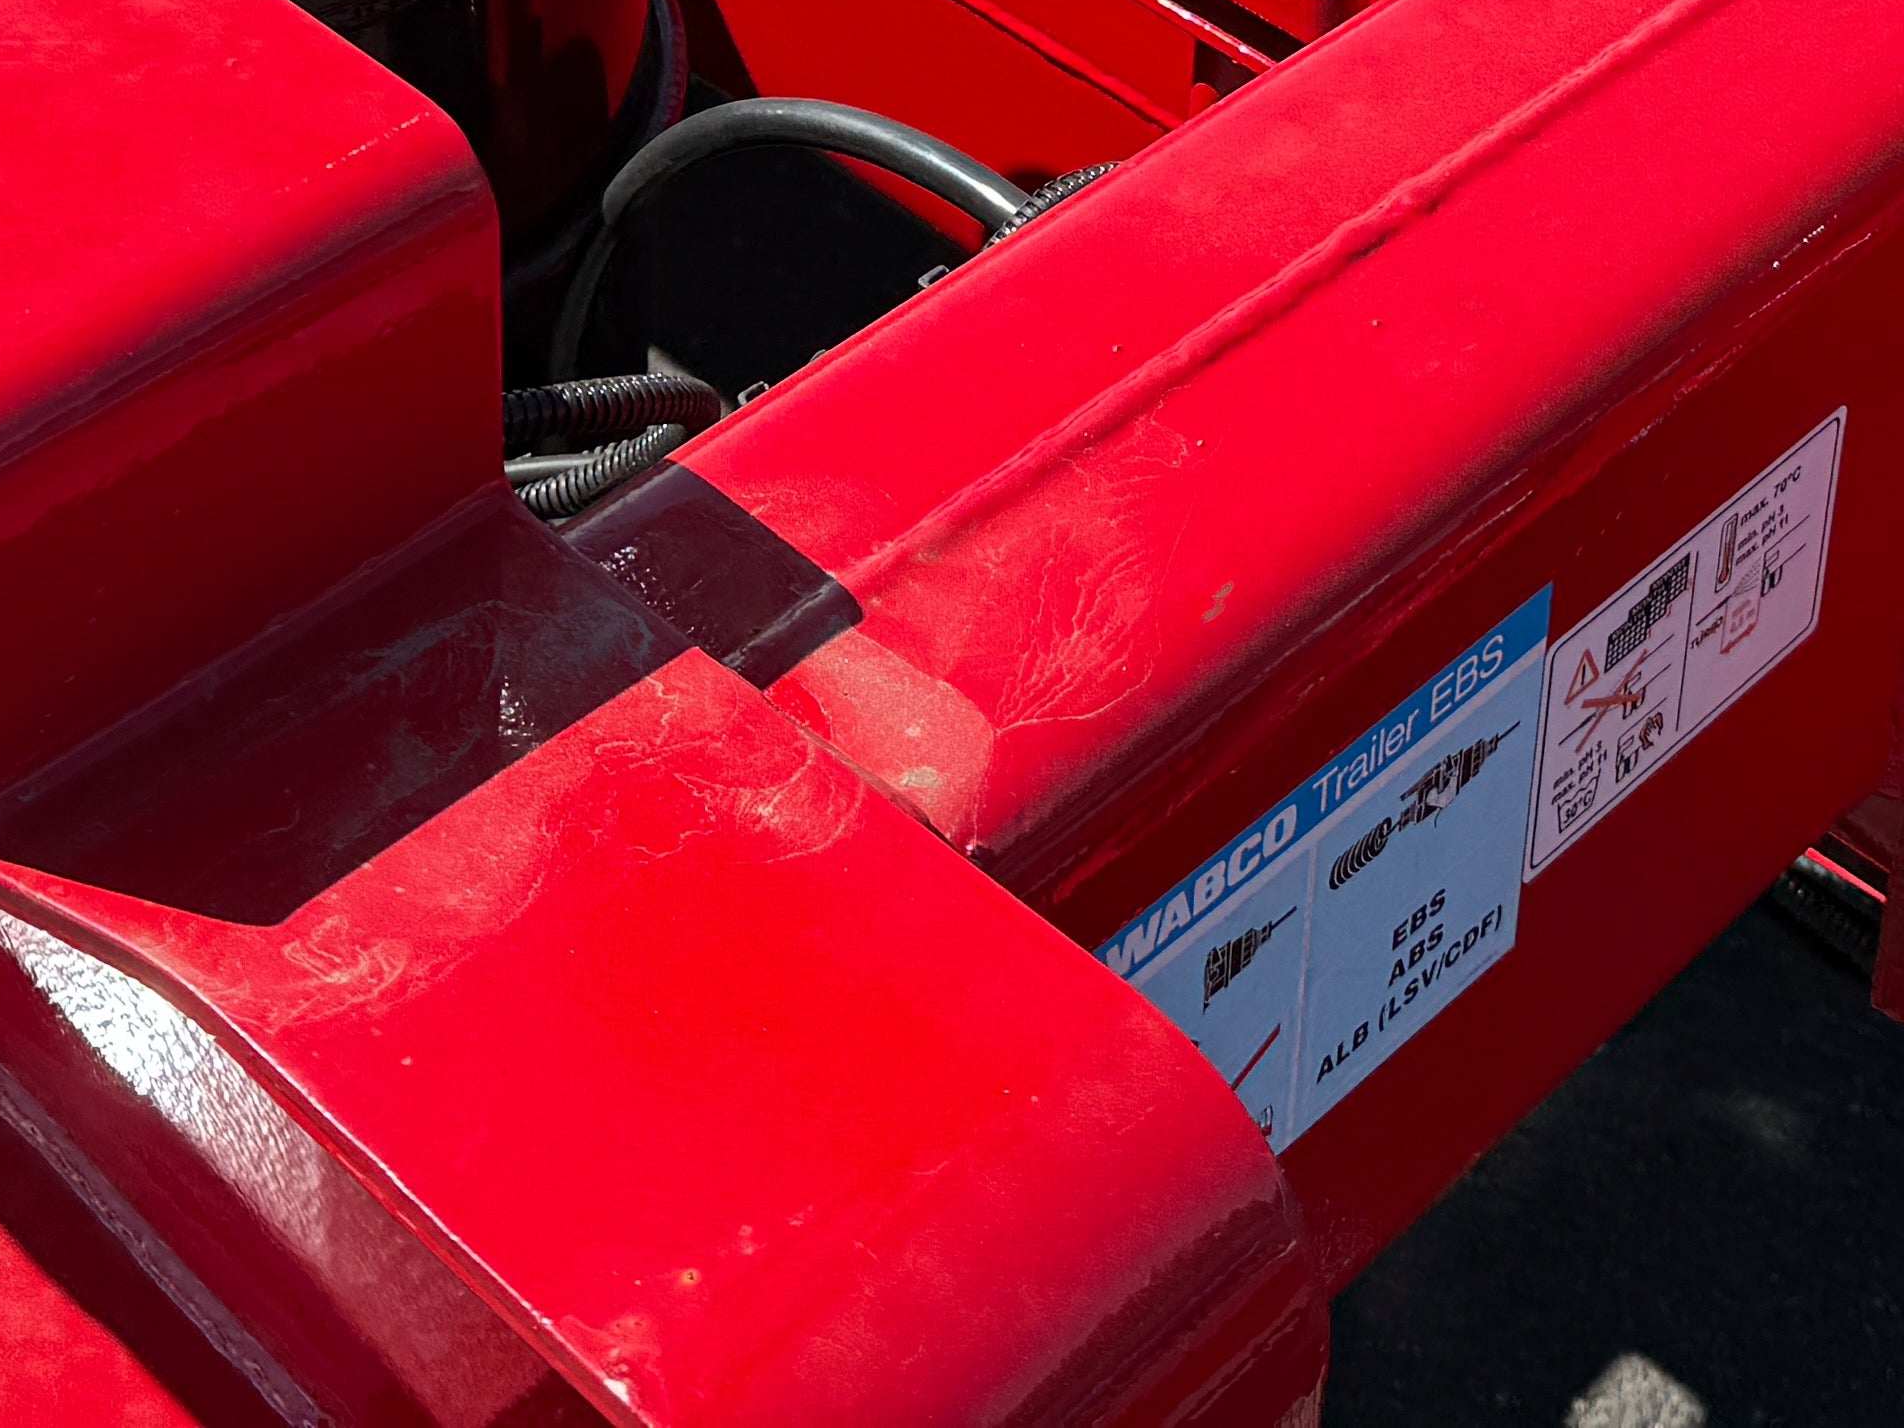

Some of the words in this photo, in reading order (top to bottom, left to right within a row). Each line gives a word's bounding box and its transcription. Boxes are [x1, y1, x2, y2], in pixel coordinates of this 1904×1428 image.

[1740, 497, 1769, 527] max.
[1773, 465, 1802, 498] 70°C
[1761, 510, 1776, 533] pH
[1762, 524, 1777, 546] pH
[1106, 803, 1297, 976] WABCO
[1312, 708, 1420, 814] Trailer
[1429, 634, 1504, 723] EBS
[1563, 790, 1593, 824] 30°C
[1391, 888, 1446, 951] EBS
[1387, 923, 1444, 988] ABS
[1316, 1021, 1369, 1085] ALB
[1378, 903, 1502, 1032] (LSV/CDF)
